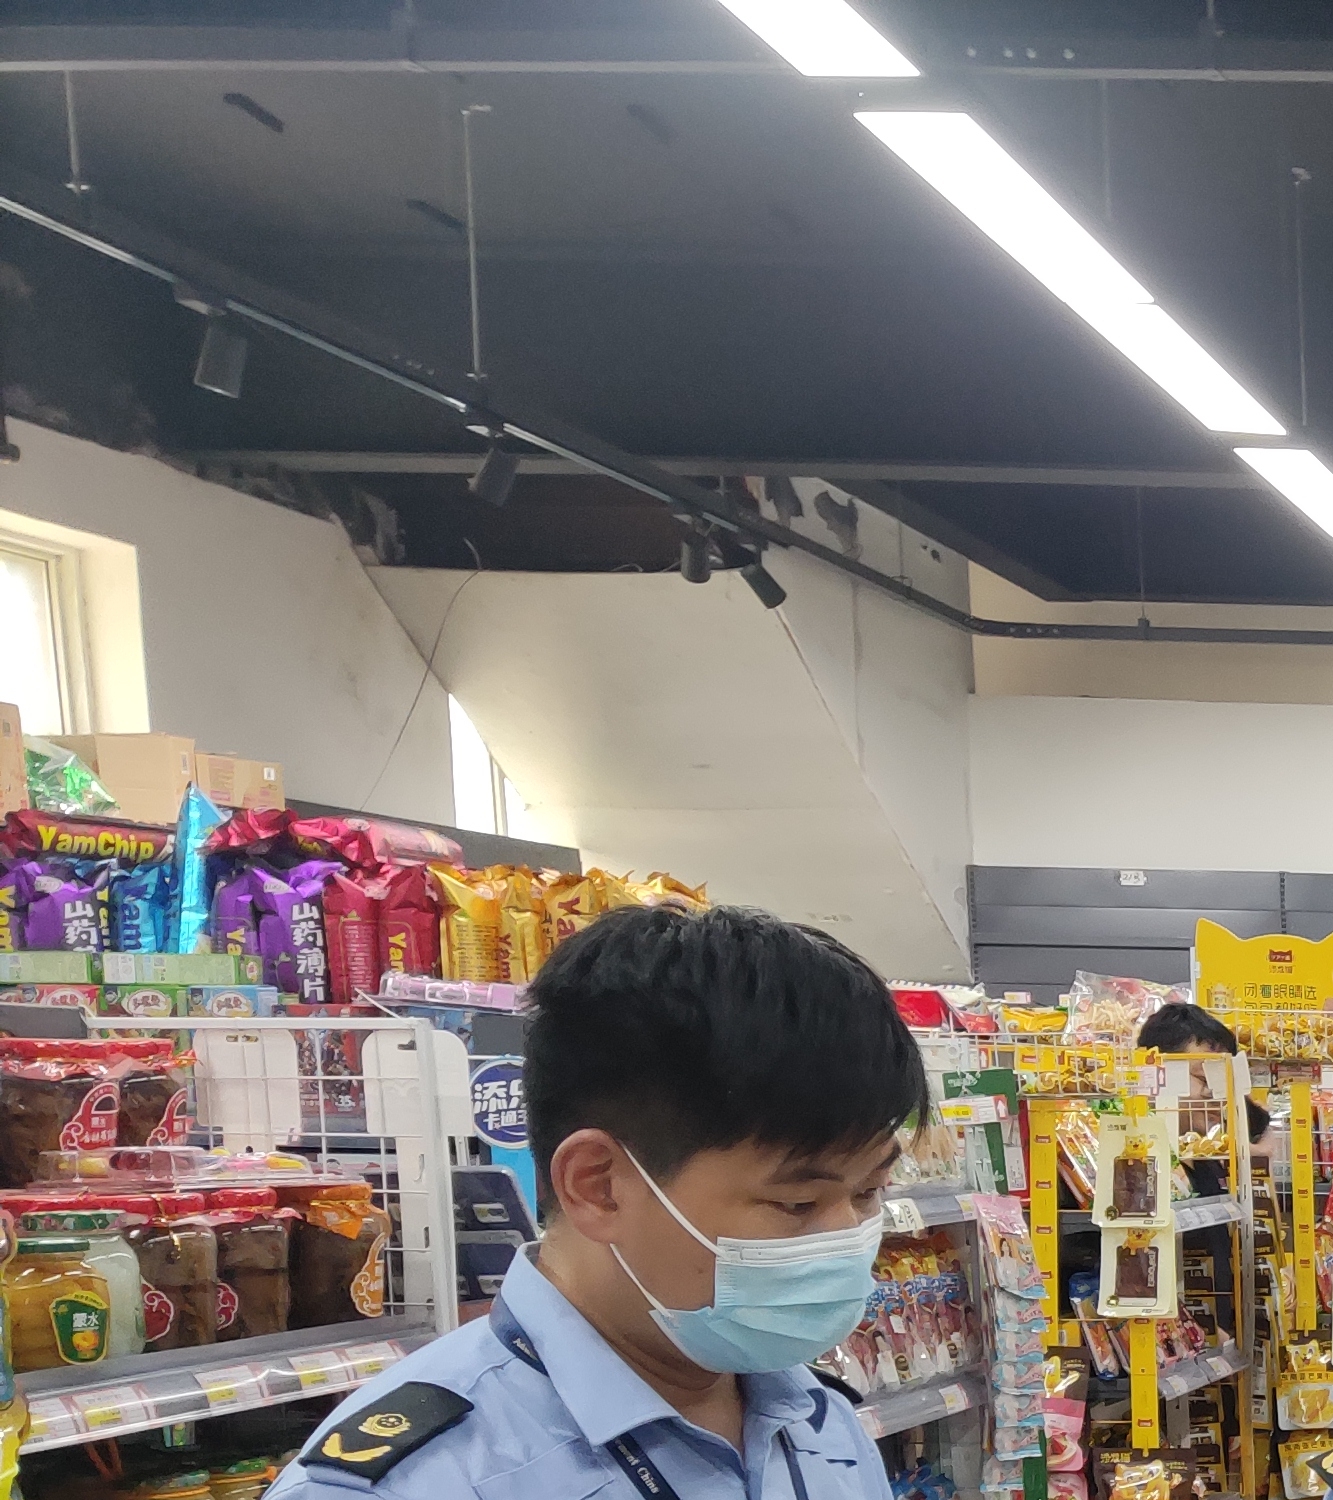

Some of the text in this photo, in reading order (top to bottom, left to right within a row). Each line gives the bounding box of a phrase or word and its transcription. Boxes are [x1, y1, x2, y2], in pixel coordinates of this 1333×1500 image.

[37, 824, 154, 863] YamChip
[62, 898, 99, 951] 山药
[290, 902, 328, 1003] 山药薄片
[636, 1464, 661, 1496] China
